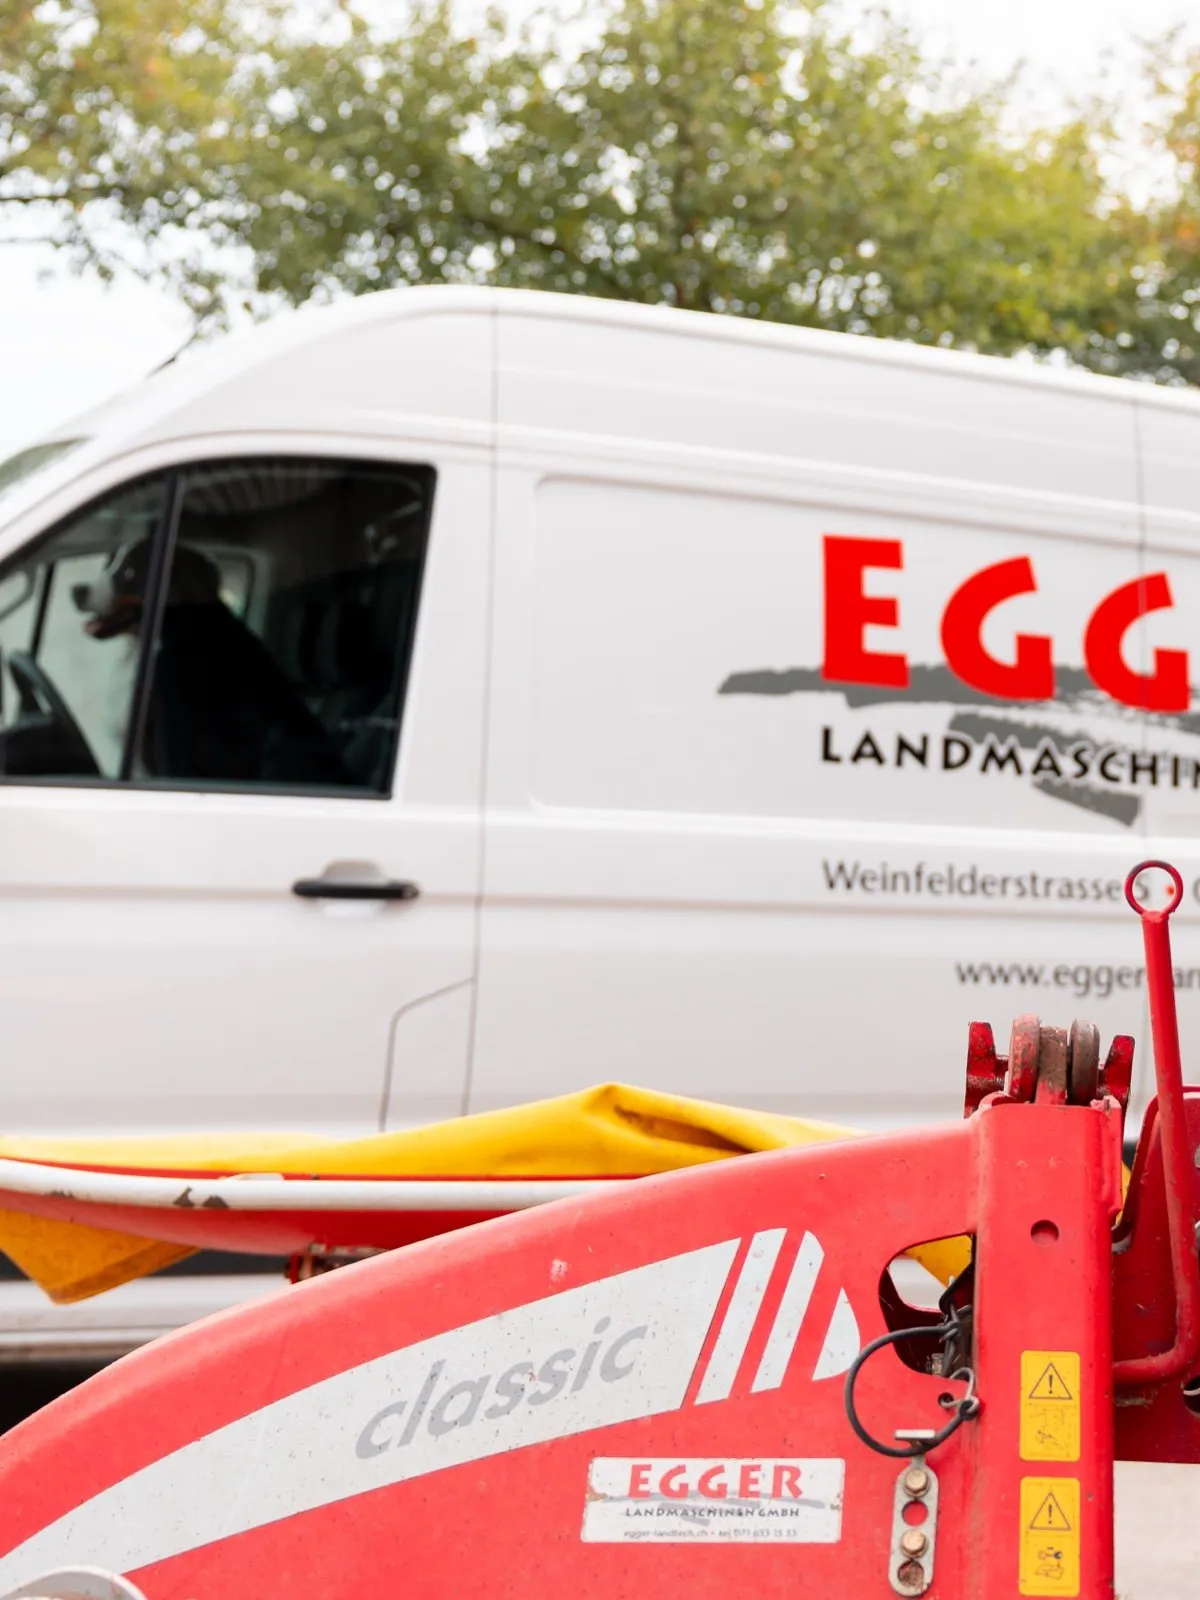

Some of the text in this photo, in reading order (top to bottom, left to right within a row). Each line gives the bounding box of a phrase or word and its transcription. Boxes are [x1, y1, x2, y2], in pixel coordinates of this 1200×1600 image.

[822, 859, 1124, 902] Weinfelderstrasse
[355, 1316, 648, 1459] classic
[627, 1464, 803, 1499] EGGER
[625, 1507, 800, 1518] LANDMASCHINEN GMBH
